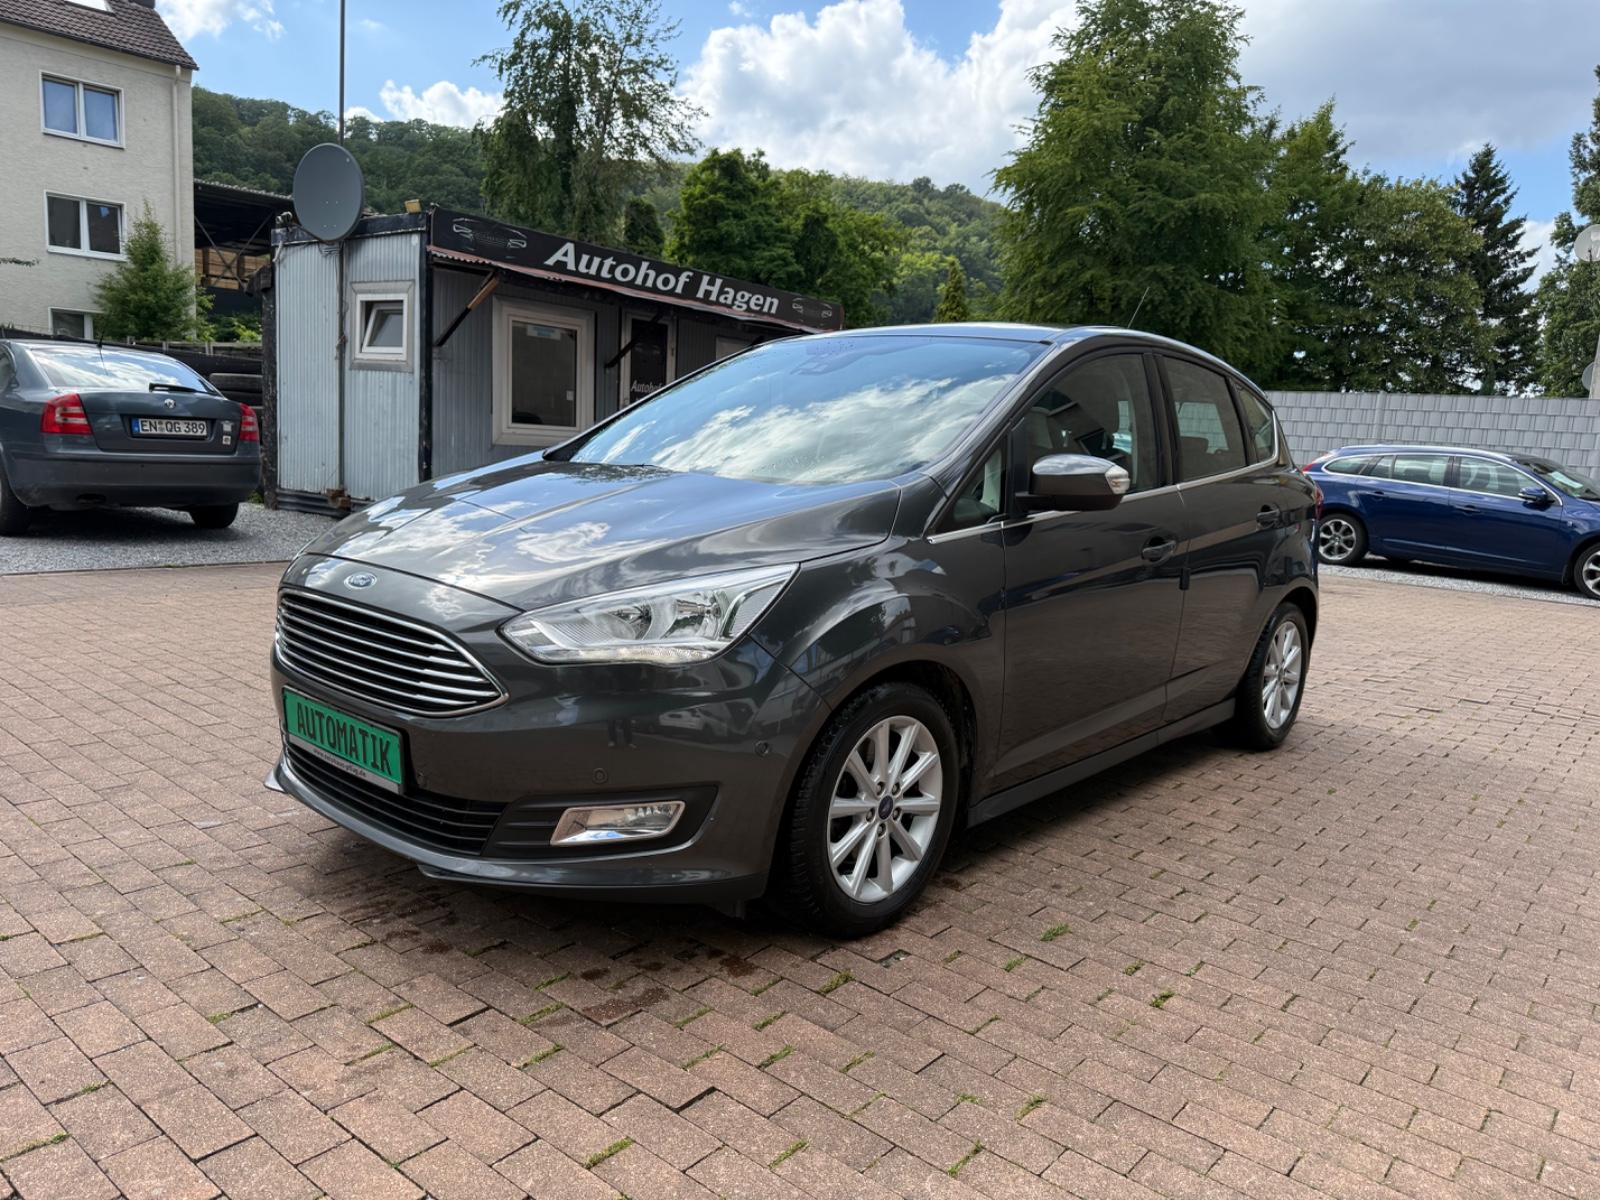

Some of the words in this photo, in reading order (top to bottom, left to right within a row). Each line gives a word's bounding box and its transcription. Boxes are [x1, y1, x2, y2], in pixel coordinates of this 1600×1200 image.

[544, 242, 694, 294] Autohof
[696, 274, 780, 315] Hagen
[141, 420, 158, 432] EN
[165, 421, 182, 433] QG
[184, 421, 206, 434] 389
[297, 701, 392, 777] AUTOMATIK
